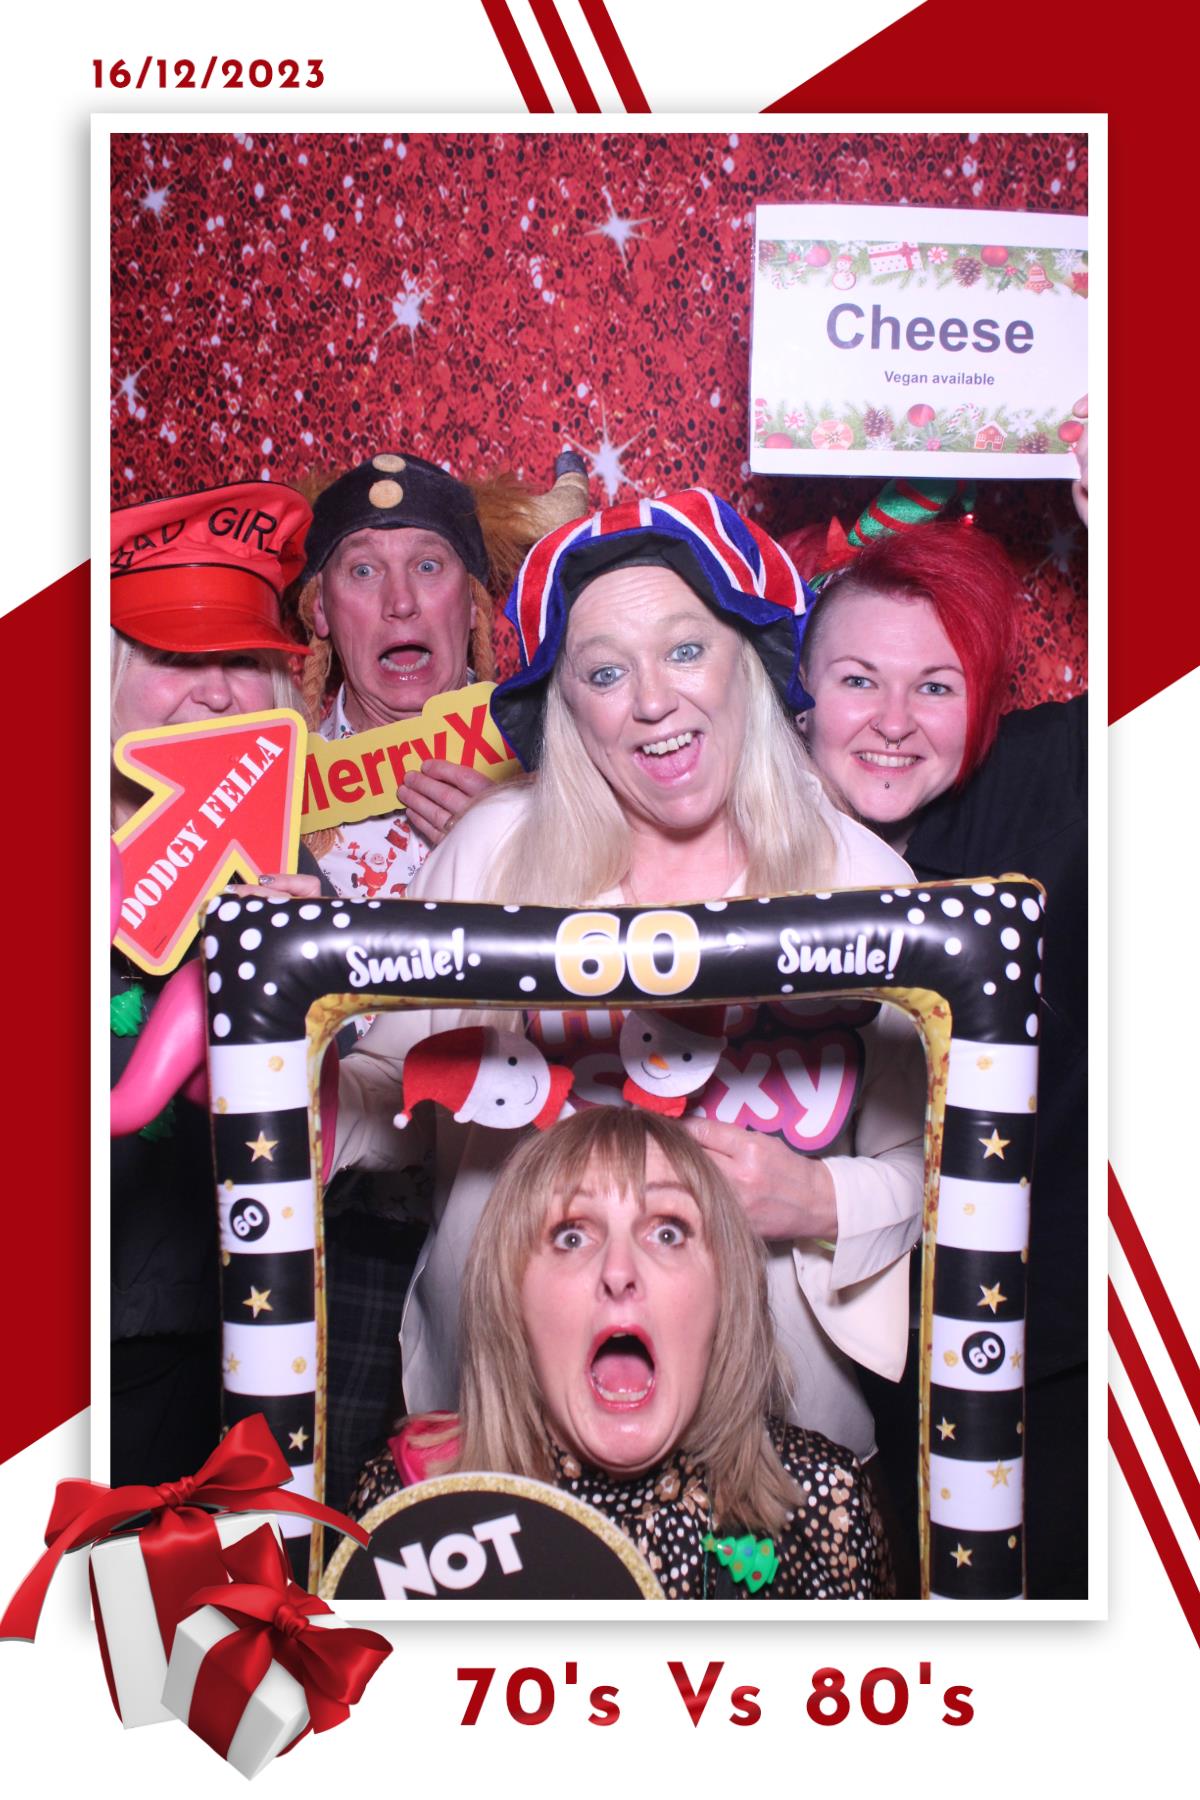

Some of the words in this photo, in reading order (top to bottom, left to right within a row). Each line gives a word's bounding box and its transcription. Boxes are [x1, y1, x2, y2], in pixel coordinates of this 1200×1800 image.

[826, 303, 1034, 354] Cheese
[884, 370, 928, 386] Vegan
[932, 372, 995, 386] available
[121, 819, 208, 930] DODGY
[198, 736, 284, 829] FELLA
[346, 927, 465, 988] Smile!
[555, 911, 700, 996] 60
[777, 928, 904, 980] Smile!
[233, 1205, 263, 1237] 60
[968, 1337, 1001, 1369] 60
[373, 1514, 524, 1600] NOT
